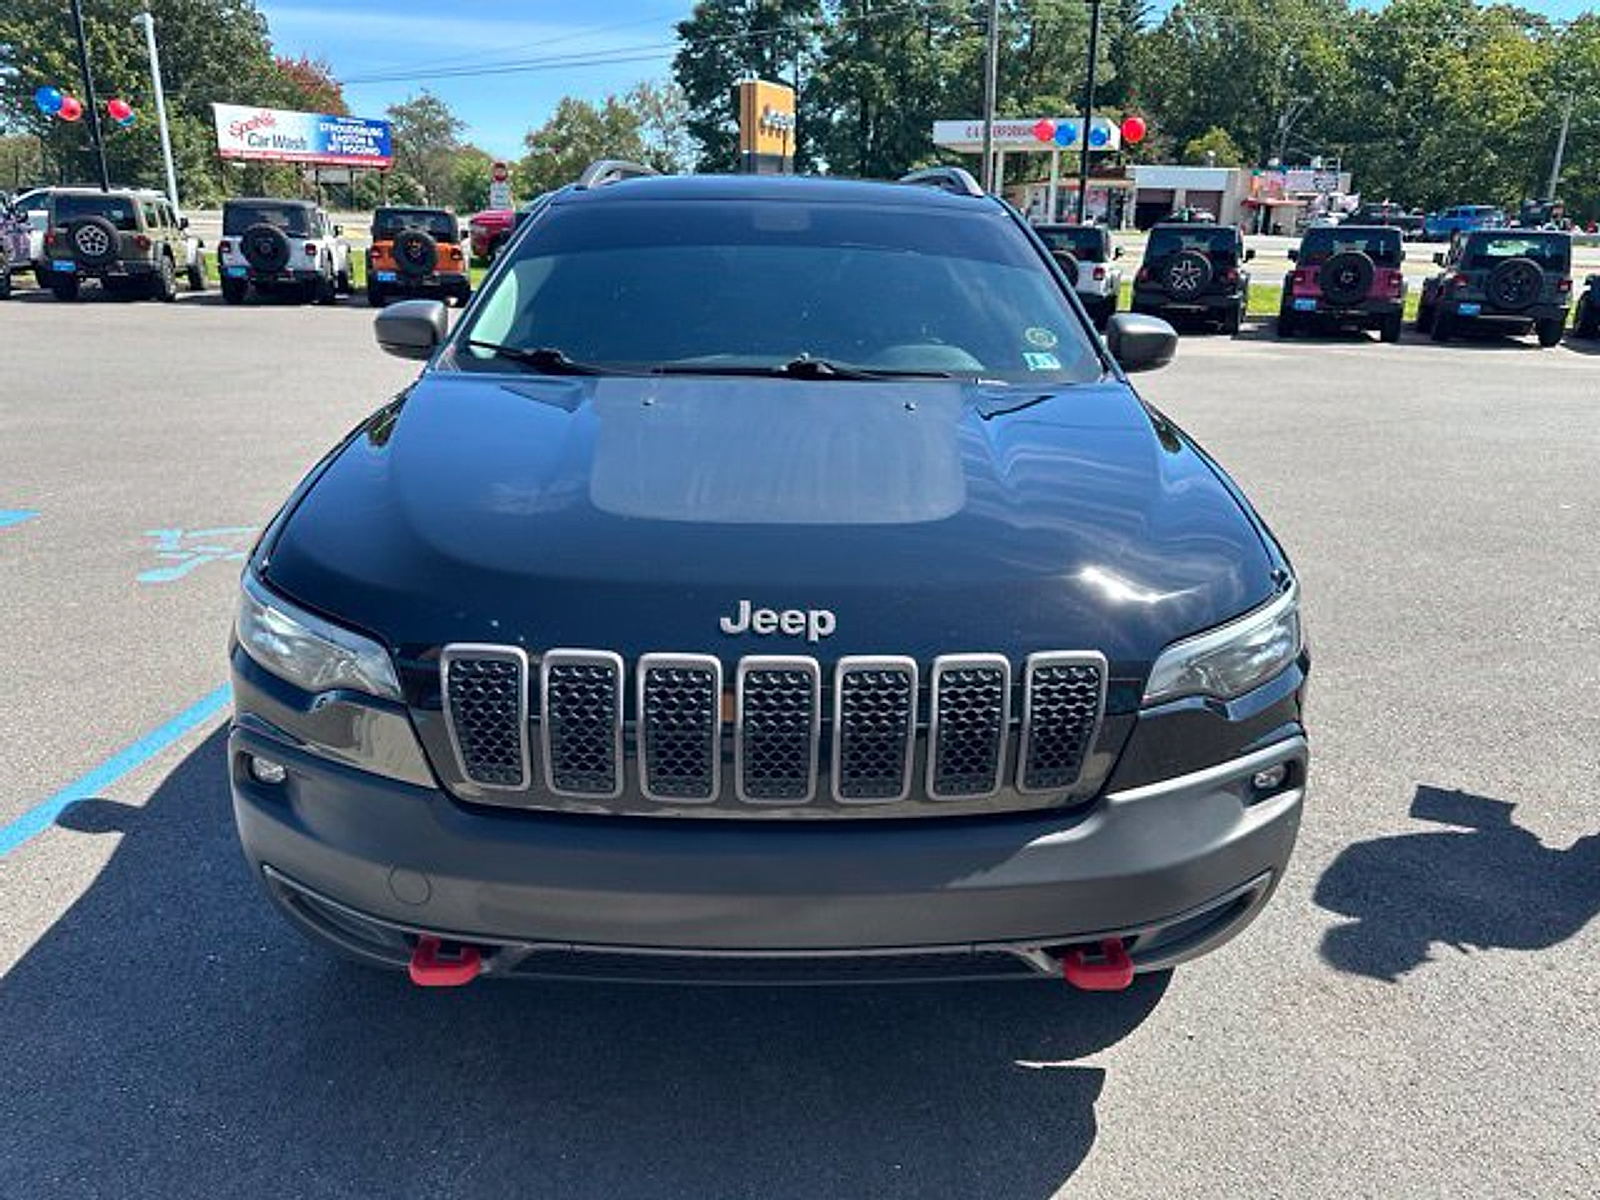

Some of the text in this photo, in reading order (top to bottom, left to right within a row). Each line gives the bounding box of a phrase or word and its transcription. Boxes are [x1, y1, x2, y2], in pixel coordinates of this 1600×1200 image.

[248, 133, 307, 150] Car Wash
[720, 600, 836, 641] Jeep
